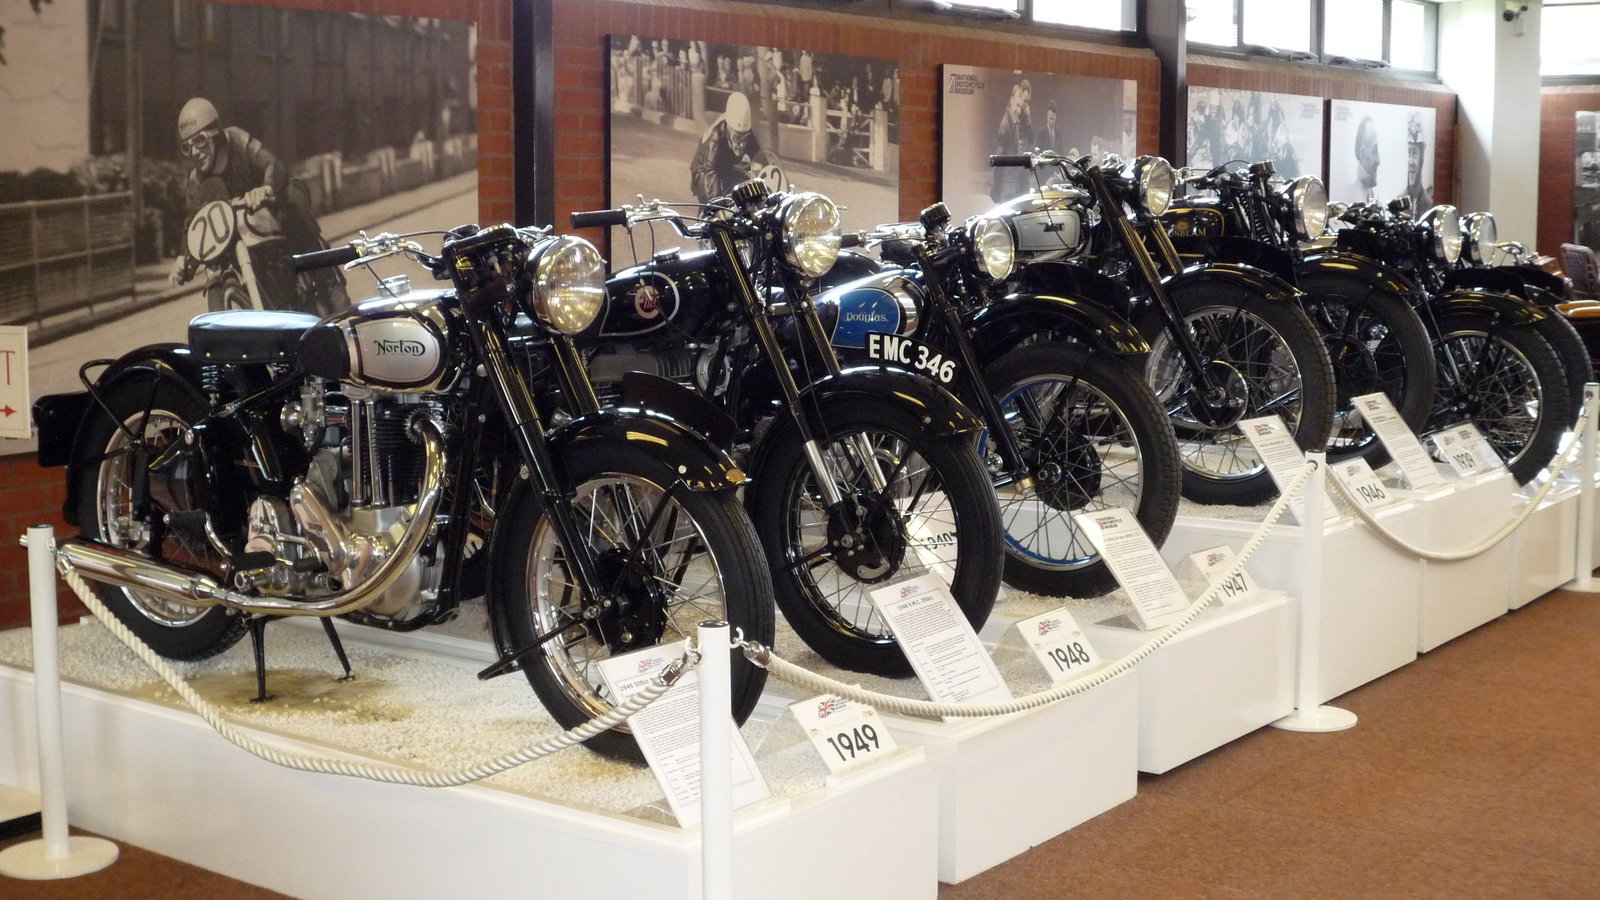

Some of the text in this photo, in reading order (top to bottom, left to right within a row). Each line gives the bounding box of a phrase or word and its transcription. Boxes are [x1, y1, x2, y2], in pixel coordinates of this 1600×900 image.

[191, 202, 231, 259] 20
[1167, 227, 1206, 237] UNBEAM
[374, 339, 426, 356] Norton
[869, 334, 956, 383] EMC 346
[1356, 483, 1386, 503] 1946
[1221, 572, 1248, 597] 1947
[1047, 641, 1090, 672] 1948
[619, 682, 634, 692] 1949
[634, 679, 650, 688] 500cc
[826, 724, 880, 762] 1949
